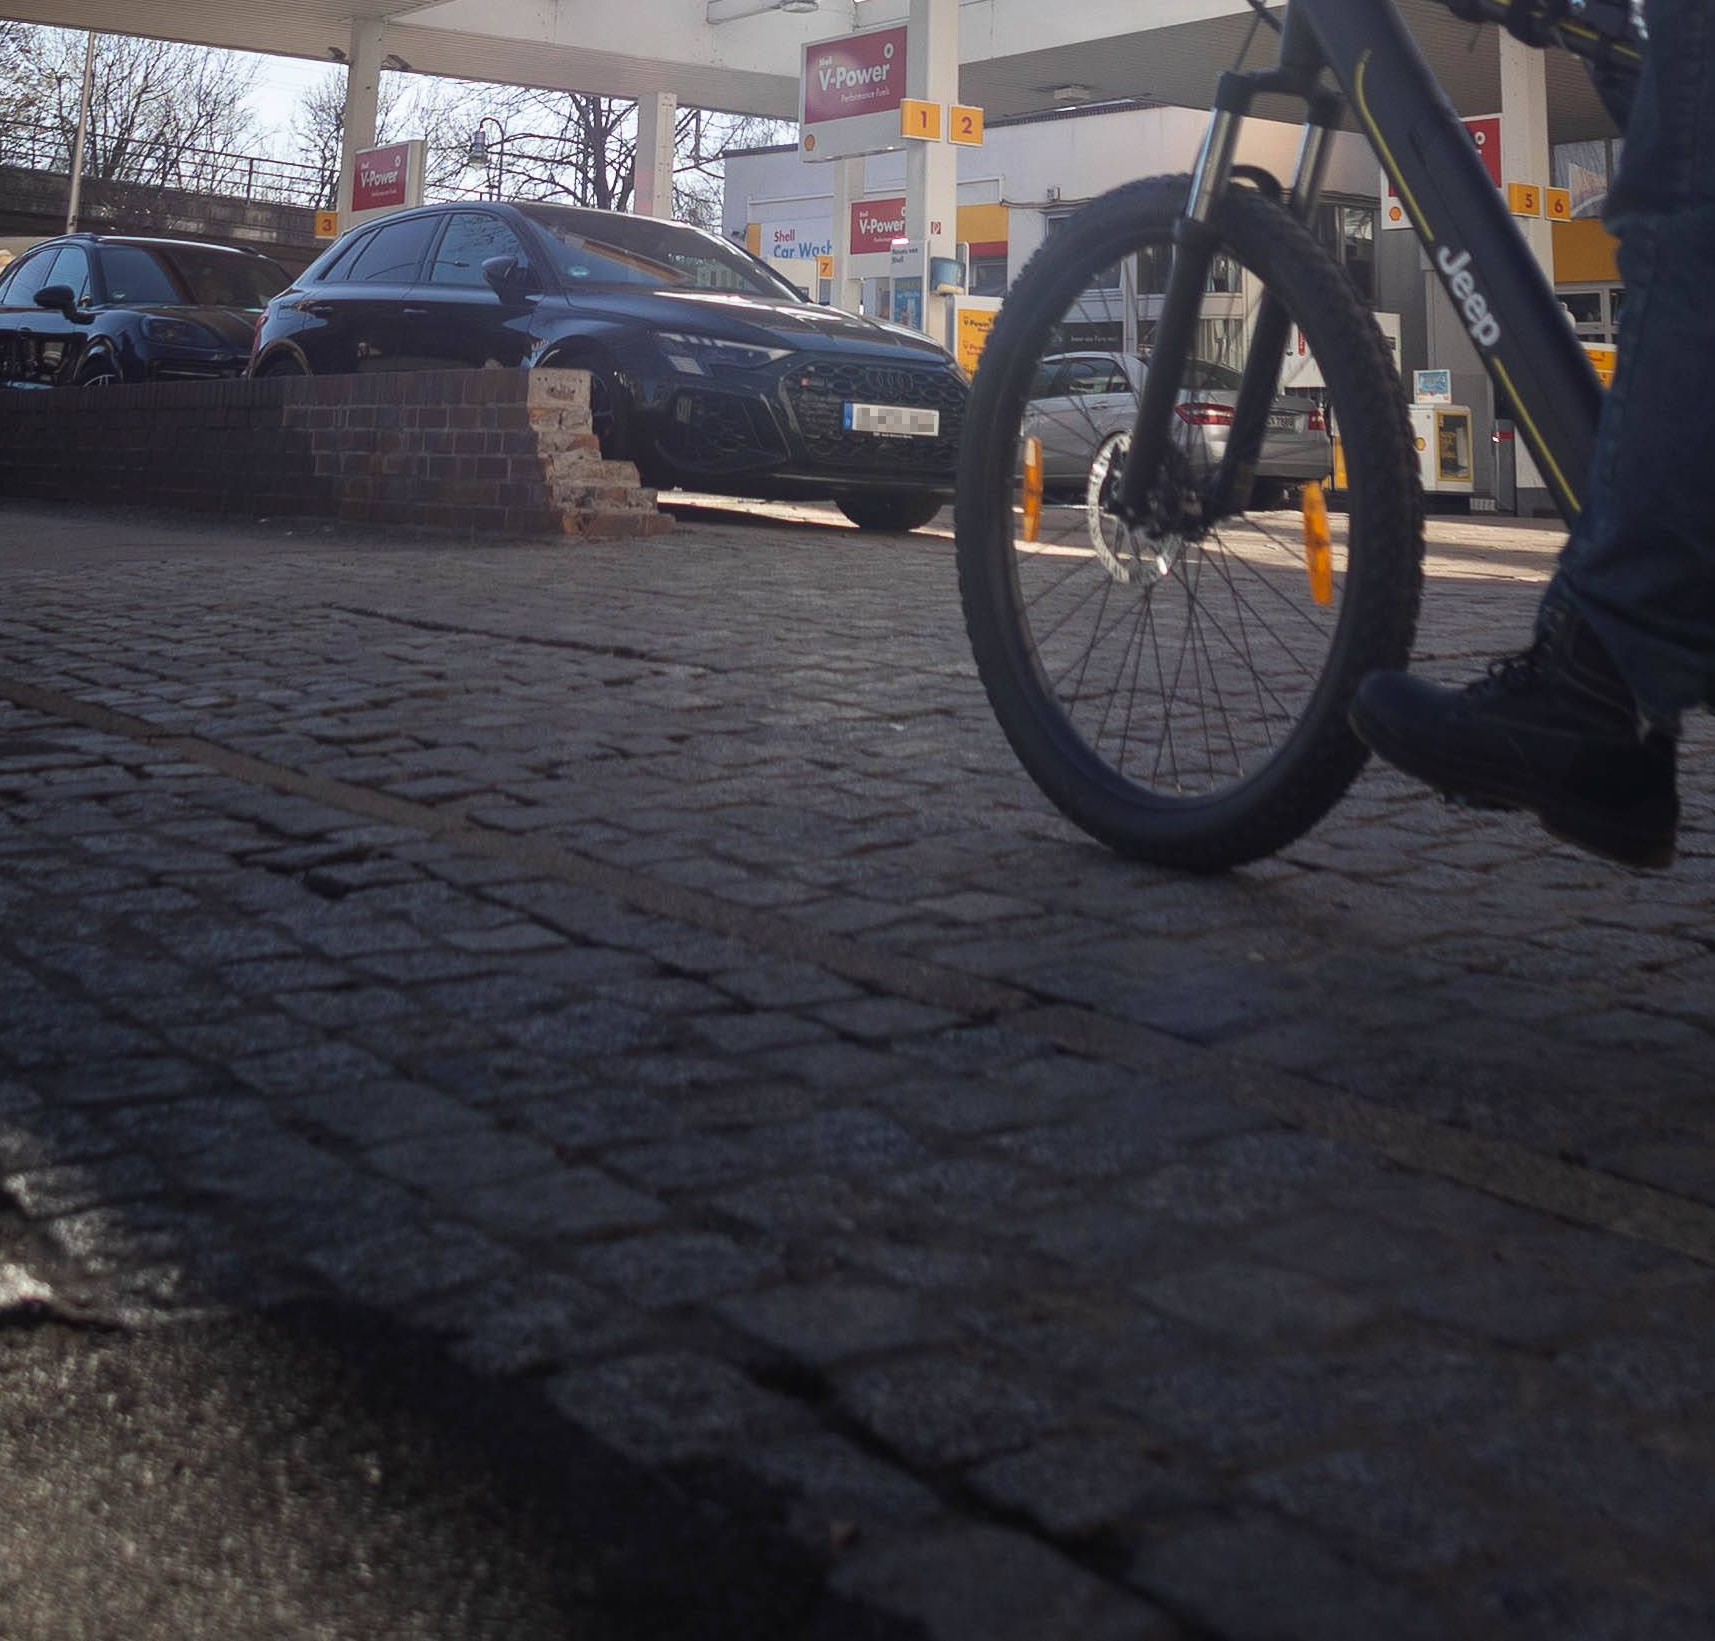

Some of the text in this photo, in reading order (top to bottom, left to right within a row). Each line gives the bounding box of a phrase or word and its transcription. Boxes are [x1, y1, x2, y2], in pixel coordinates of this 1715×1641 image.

[818, 62, 891, 91] V-Power
[920, 110, 928, 129] 1
[961, 116, 973, 135] 2
[360, 170, 399, 188] V-Power
[1525, 192, 1534, 209] 5
[1554, 198, 1564, 213] 6
[323, 219, 332, 232] 3
[859, 218, 906, 236] V-Power
[773, 228, 796, 243] Shell
[773, 243, 795, 259] Car
[820, 262, 830, 273] 7
[1438, 245, 1502, 347] Jeep
